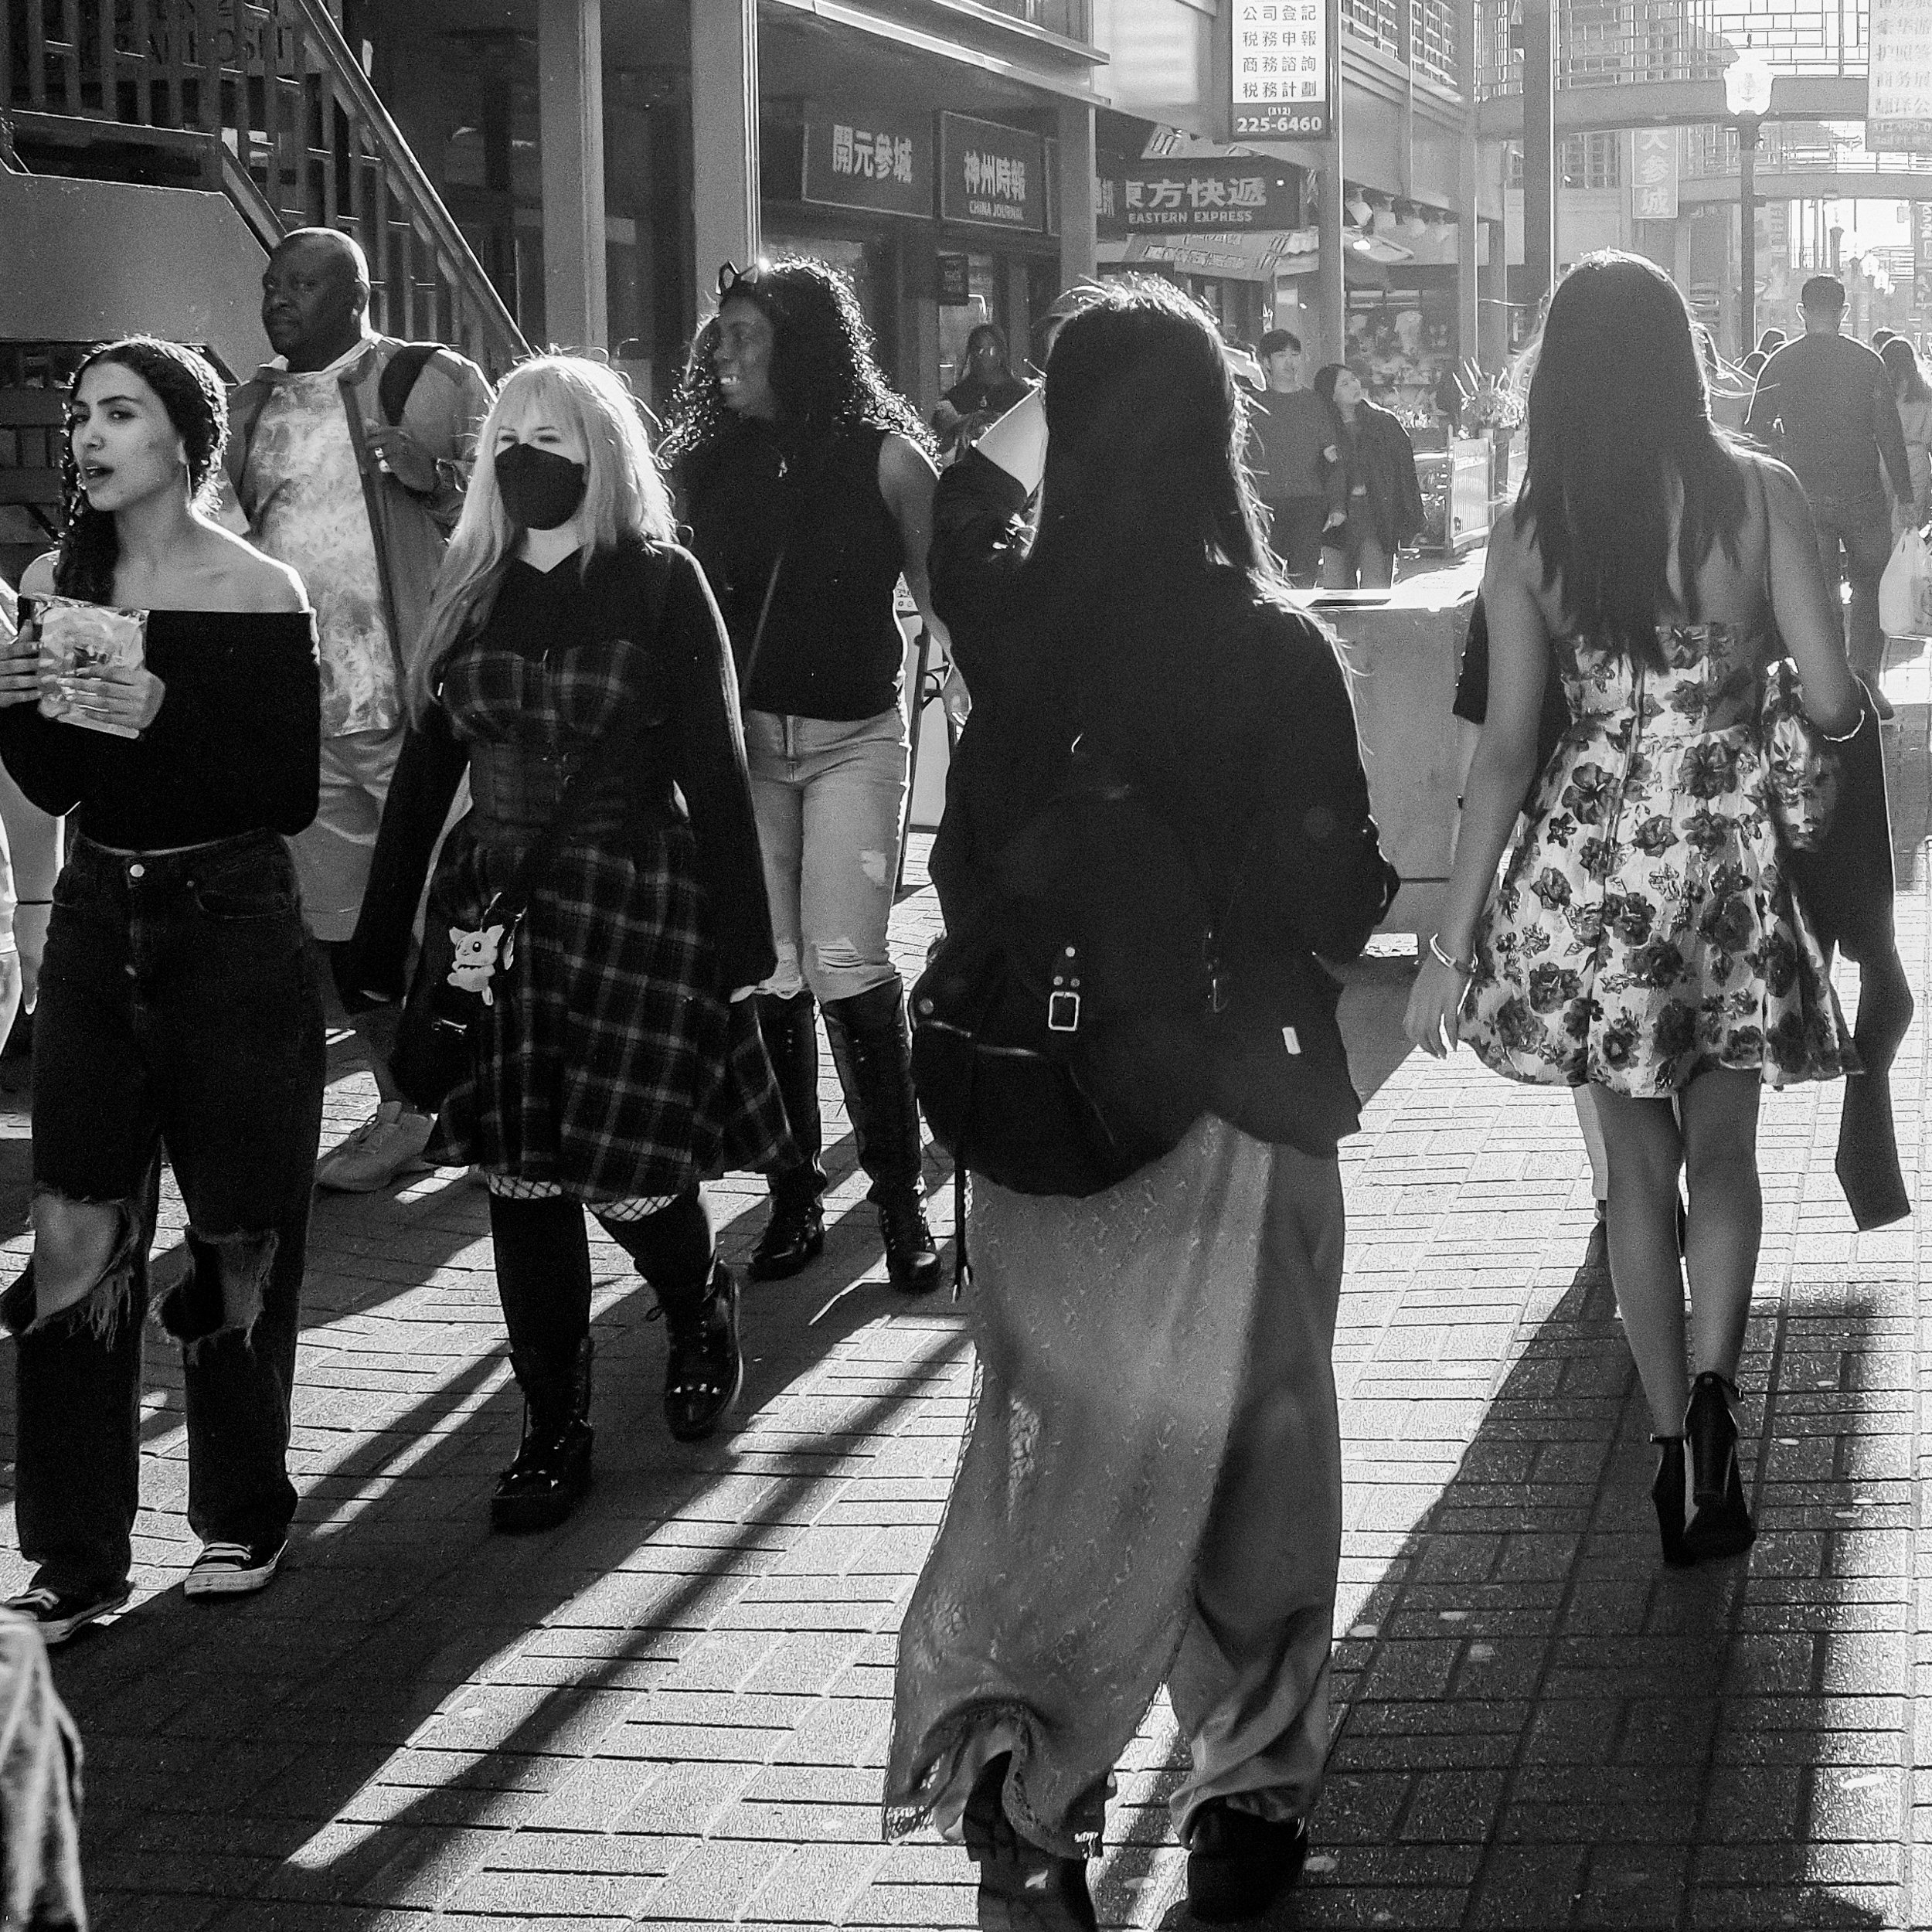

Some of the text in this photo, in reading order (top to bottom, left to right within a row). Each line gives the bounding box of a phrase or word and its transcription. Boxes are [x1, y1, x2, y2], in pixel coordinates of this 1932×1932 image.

[1243, 5, 1317, 21] 公司登記
[1236, 116, 1322, 133] 225-6460
[969, 199, 992, 217] CHINA
[1128, 210, 1253, 224] EASTERN EXPRESS
